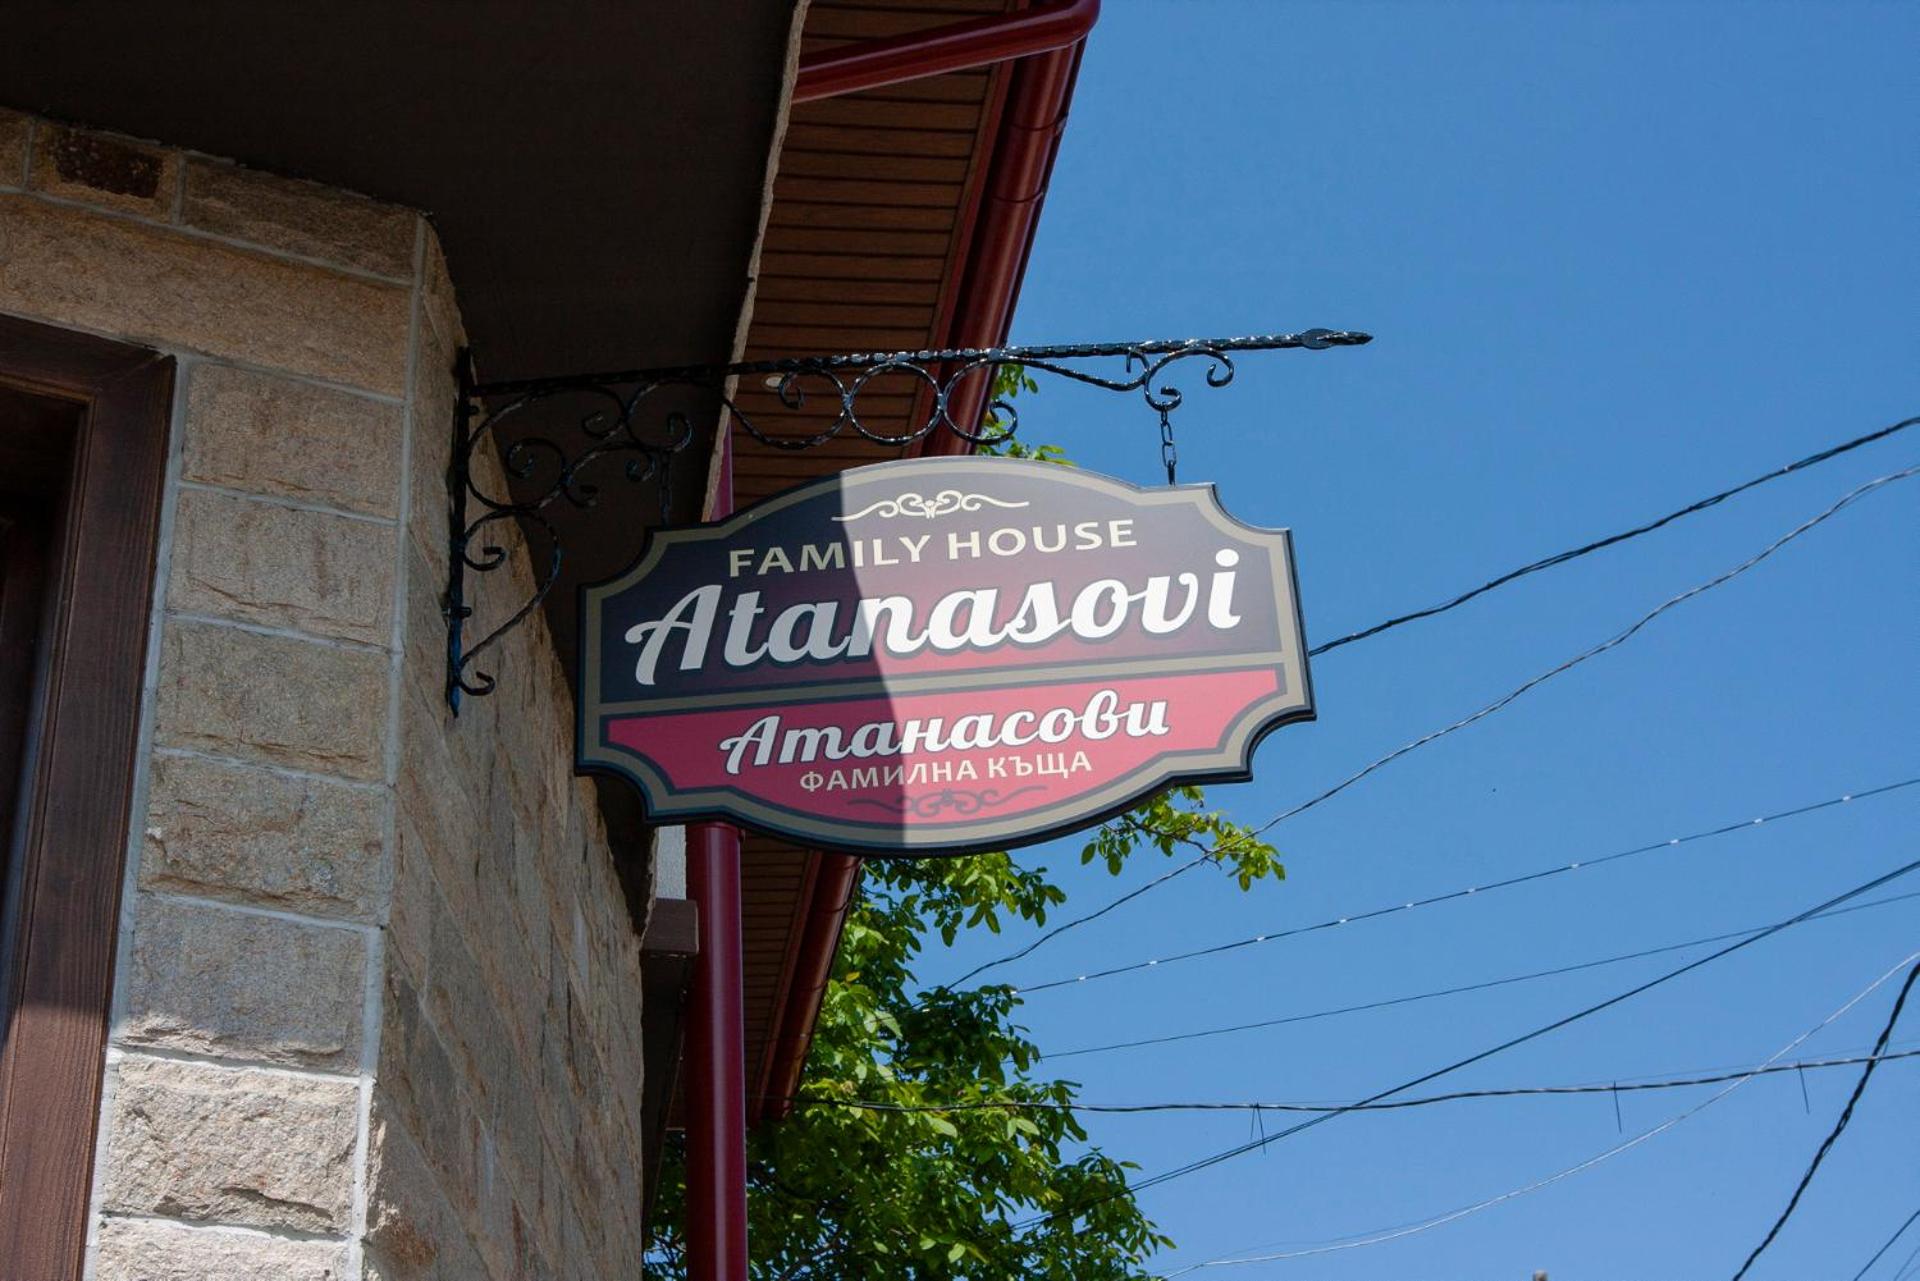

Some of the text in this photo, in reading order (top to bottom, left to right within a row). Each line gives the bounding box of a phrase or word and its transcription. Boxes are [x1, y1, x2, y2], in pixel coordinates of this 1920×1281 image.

[729, 519, 1138, 578] FAMILY HOUSE
[625, 549, 1242, 686] Atanasovi
[719, 690, 1169, 774] Атанасови
[799, 750, 1093, 793] ФАМИЛНА КЪЩА
